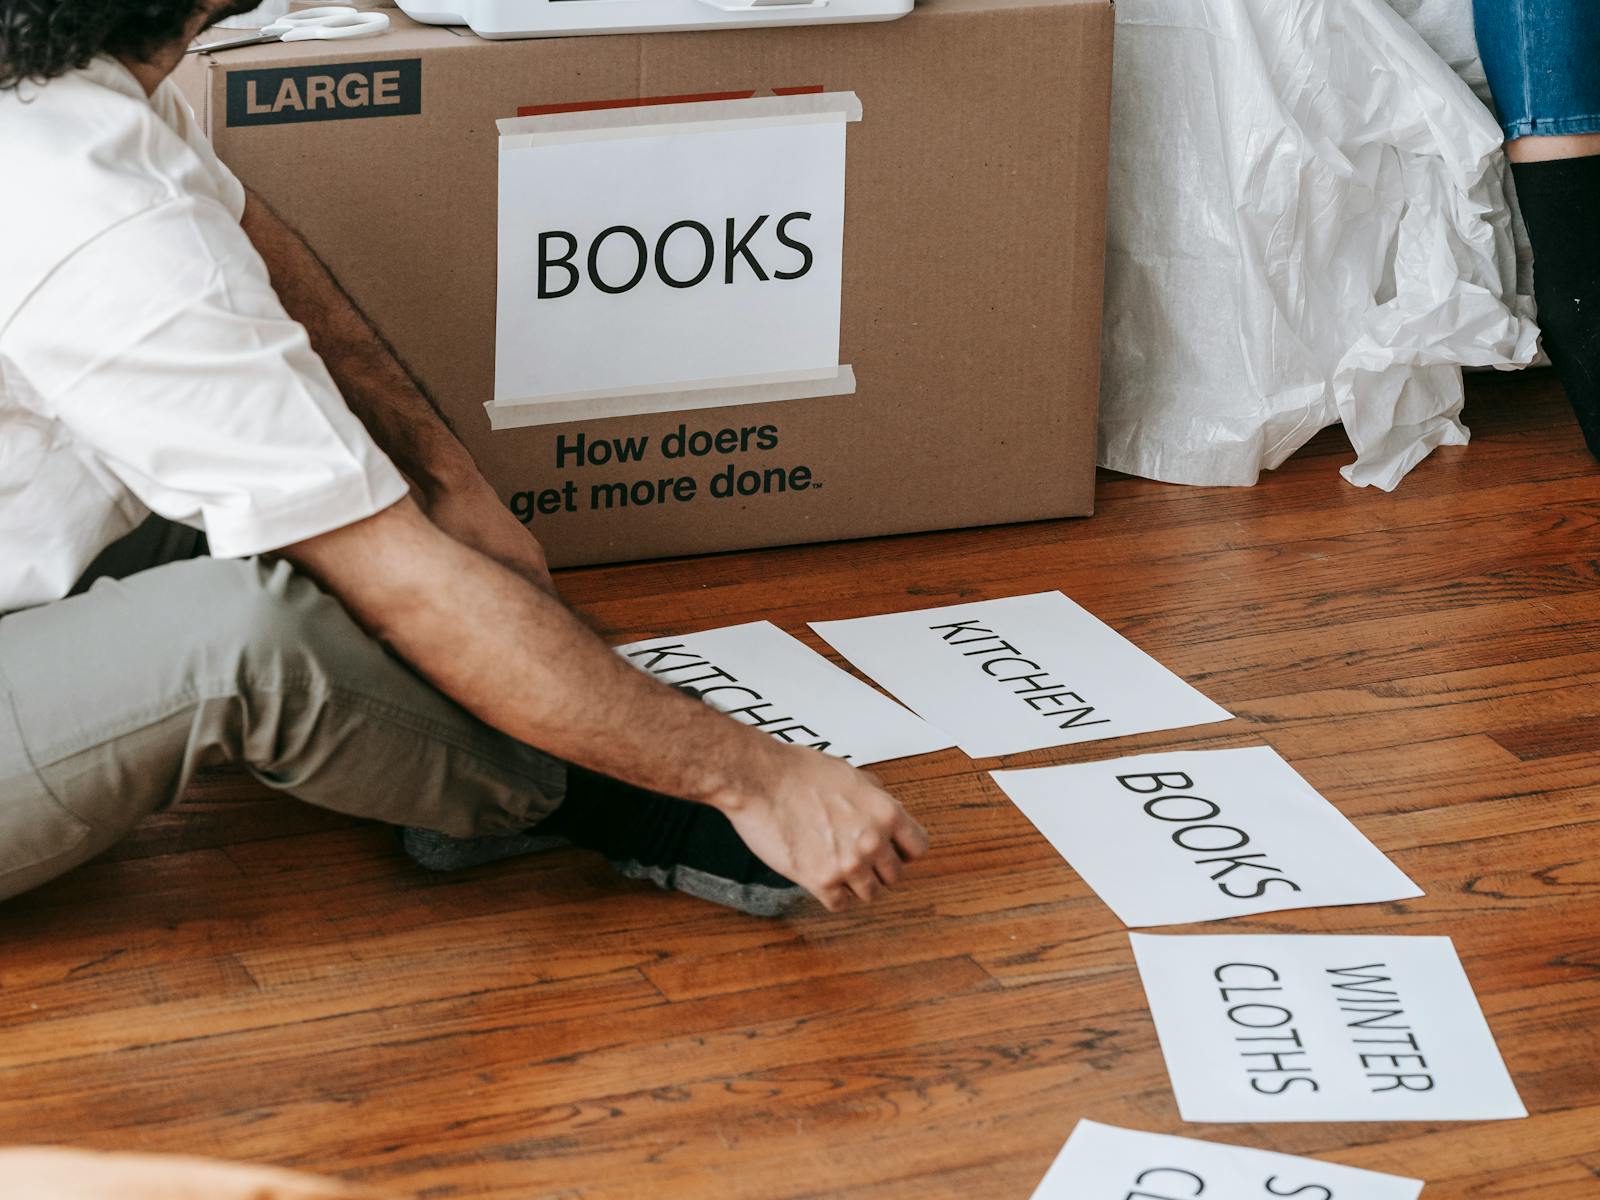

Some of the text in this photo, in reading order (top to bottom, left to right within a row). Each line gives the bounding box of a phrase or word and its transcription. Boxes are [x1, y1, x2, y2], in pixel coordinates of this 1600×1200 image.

[246, 70, 401, 115] LARGE
[537, 211, 814, 300] BOOKS
[555, 424, 779, 469] How doers
[510, 480, 577, 525] get
[590, 475, 697, 510] more
[928, 619, 1112, 729] KITCHEN
[1115, 771, 1302, 899] BOOKS
[1213, 962, 1320, 1095] CLOTHS
[1325, 963, 1435, 1093] WINTER
